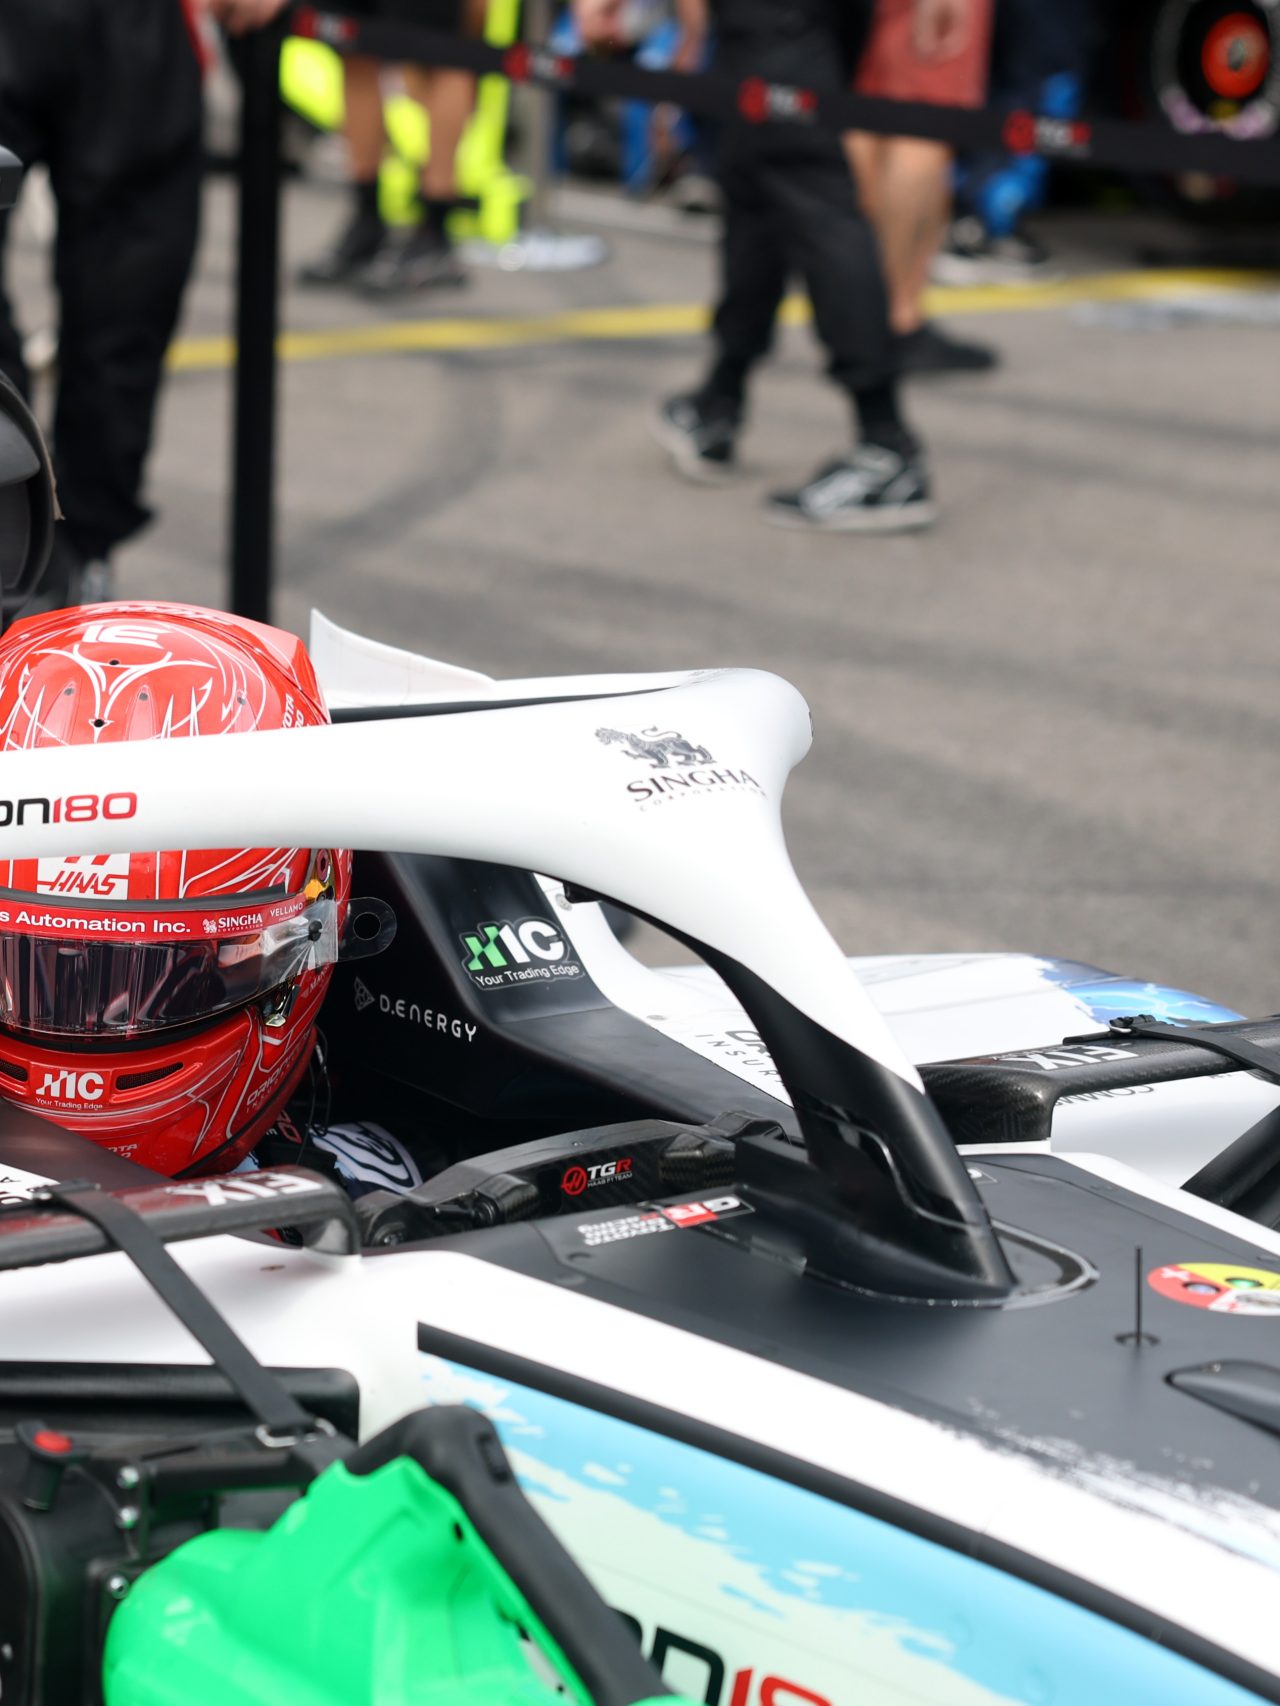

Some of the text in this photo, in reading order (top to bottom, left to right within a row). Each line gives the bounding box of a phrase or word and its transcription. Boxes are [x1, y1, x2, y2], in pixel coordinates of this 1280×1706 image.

[625, 768, 761, 802] SINGHA
[42, 870, 124, 896] HAAS
[15, 910, 151, 933] Automation
[153, 919, 191, 933] Inc.
[218, 912, 264, 929] SINGHA
[270, 902, 304, 918] VELLAMO
[475, 963, 580, 988] Your Trading Edge
[379, 994, 477, 1042] D.ENERGY
[695, 1034, 781, 1080] INSUR
[35, 1097, 103, 1110] Your Trading Edge
[587, 1157, 633, 1181] TGR
